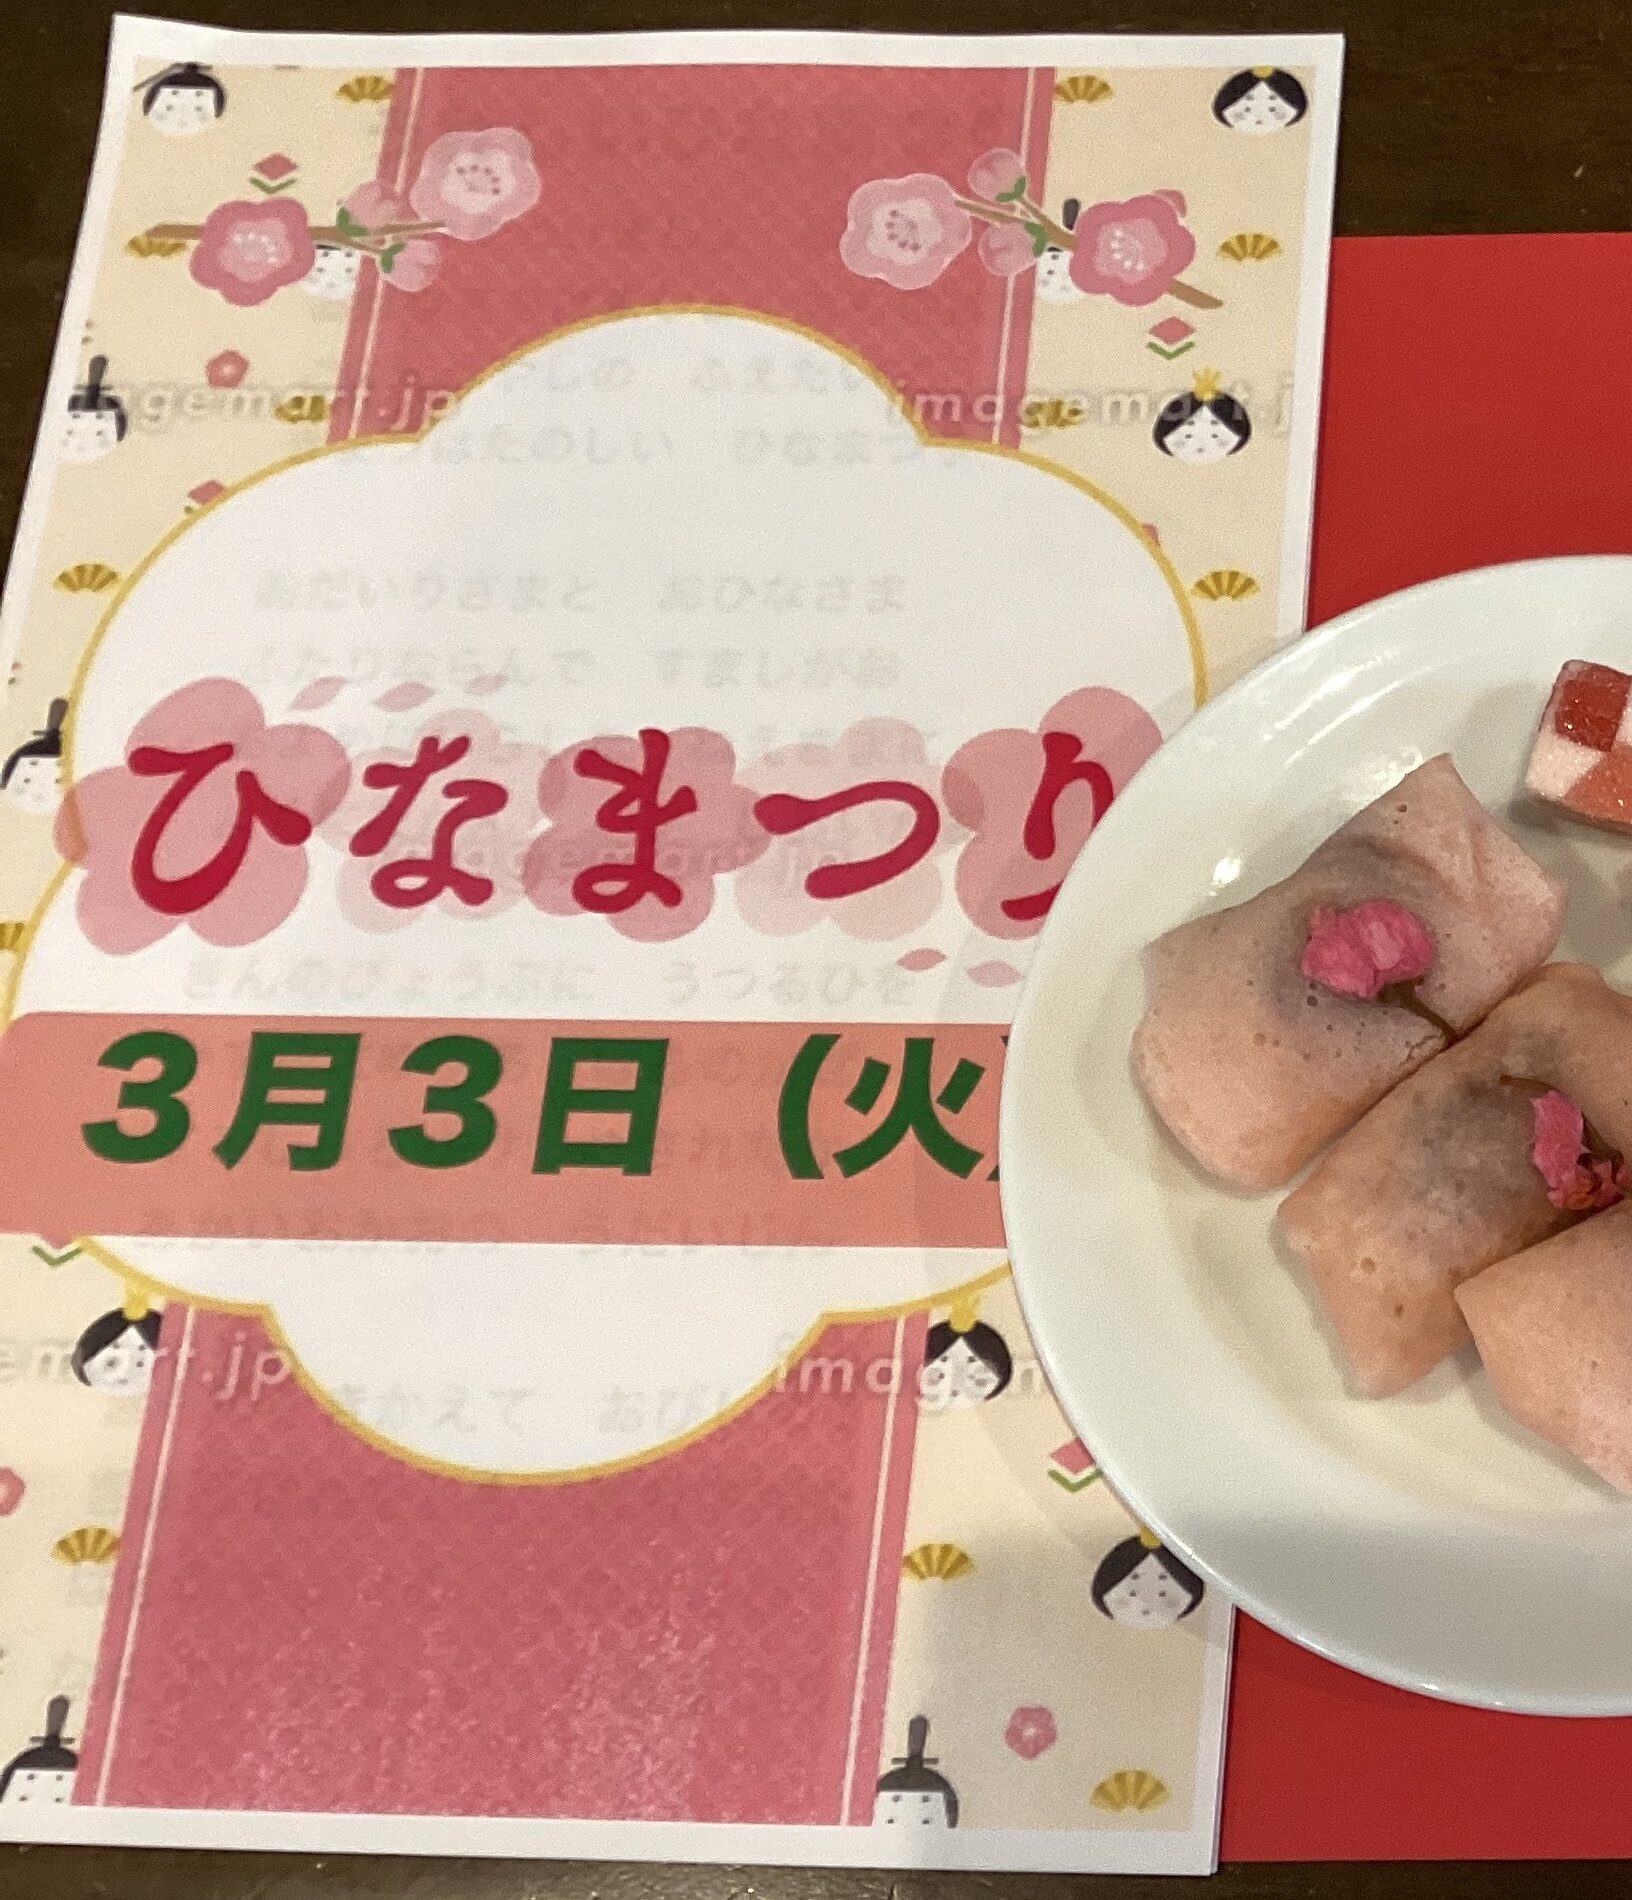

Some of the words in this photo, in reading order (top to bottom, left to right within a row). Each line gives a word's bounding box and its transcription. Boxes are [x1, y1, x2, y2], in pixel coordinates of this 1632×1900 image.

[128, 724, 1113, 920] ひなまつり
